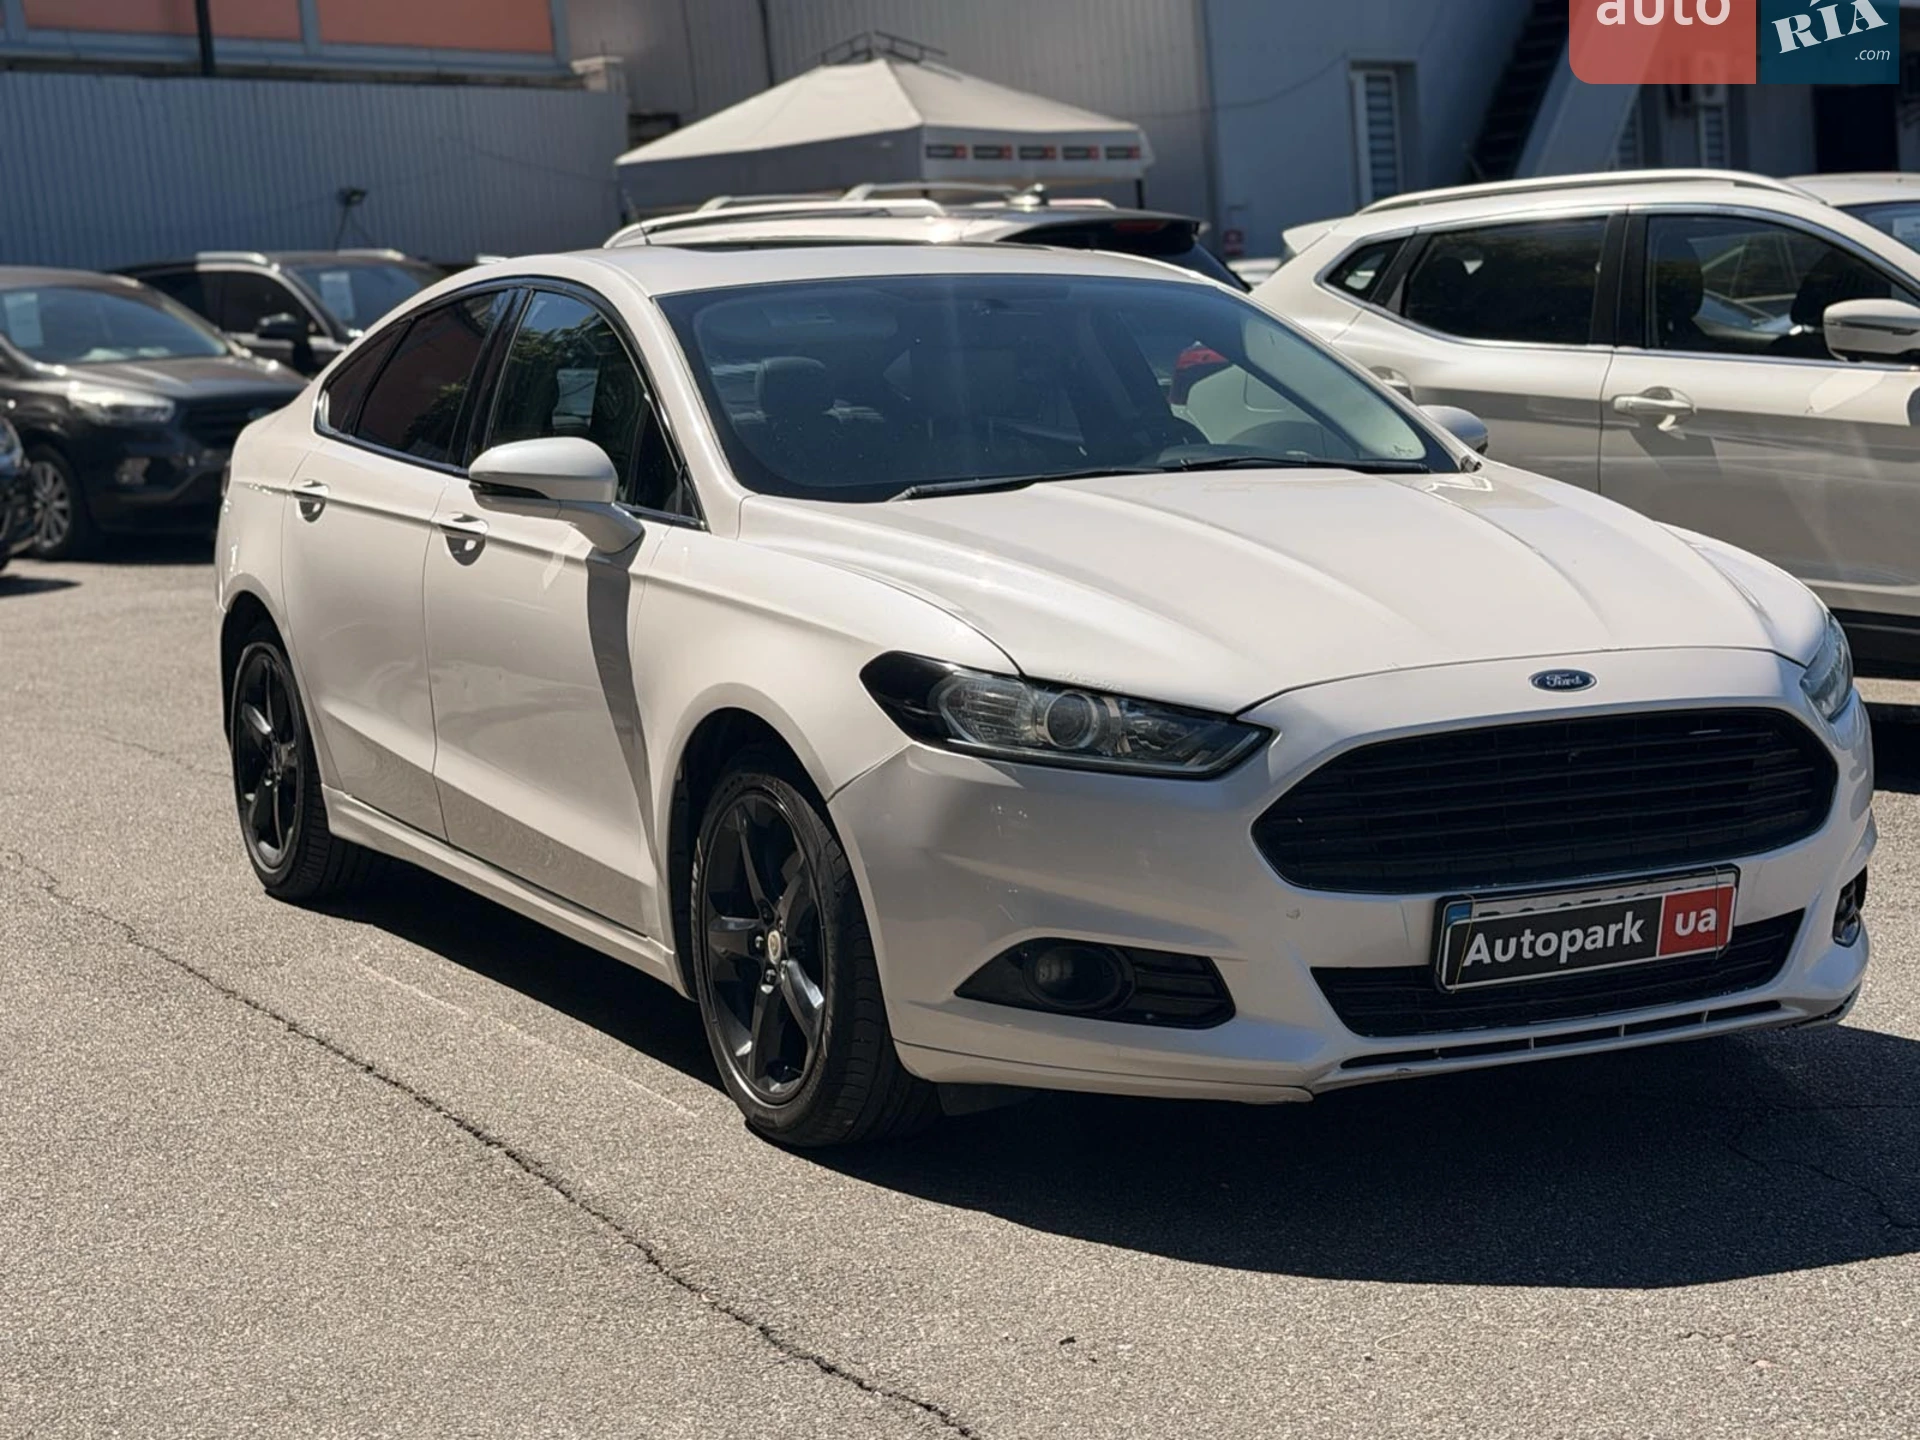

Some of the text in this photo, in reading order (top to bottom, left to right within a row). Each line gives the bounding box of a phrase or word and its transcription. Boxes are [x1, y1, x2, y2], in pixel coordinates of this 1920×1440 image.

[1546, 674, 1583, 687] Ford
[1463, 907, 1718, 967] Autopark ua
